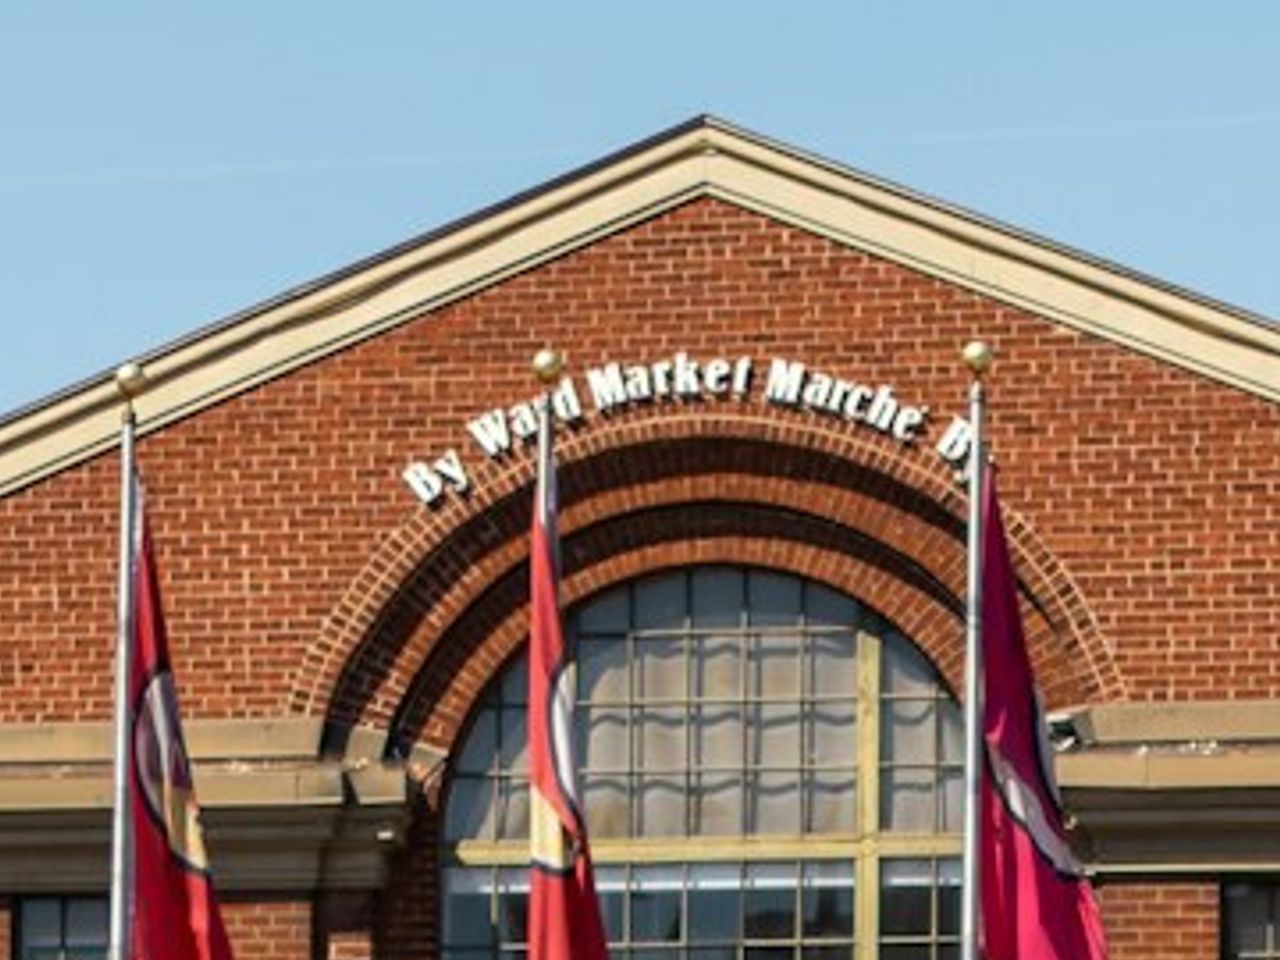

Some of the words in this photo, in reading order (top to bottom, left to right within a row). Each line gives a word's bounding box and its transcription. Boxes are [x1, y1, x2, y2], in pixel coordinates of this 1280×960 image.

[402, 447, 468, 503] By
[466, 375, 582, 456] Ward
[586, 351, 752, 411] Market
[765, 357, 931, 441] Marché
